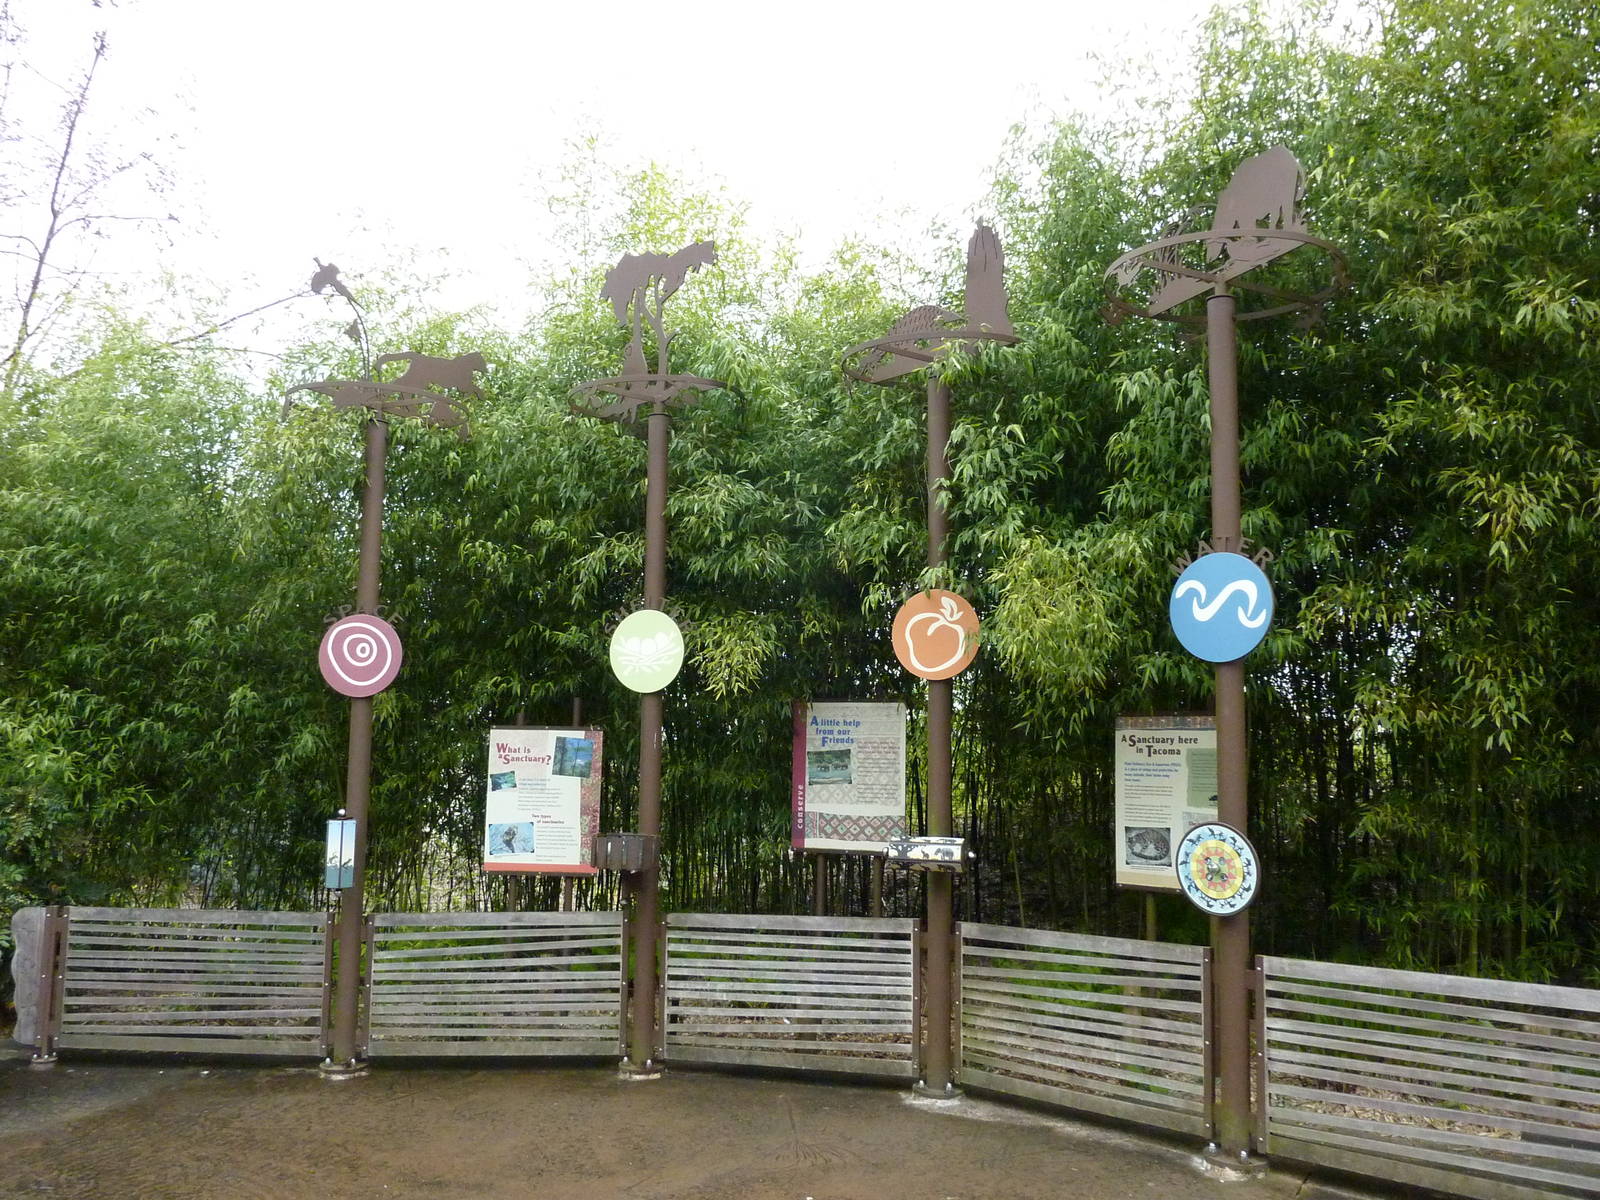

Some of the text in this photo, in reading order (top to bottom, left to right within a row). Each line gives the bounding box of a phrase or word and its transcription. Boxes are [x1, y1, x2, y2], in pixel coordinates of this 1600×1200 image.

[1168, 536, 1275, 577] WATER
[810, 715, 818, 726] A
[843, 719, 861, 728] help
[816, 727, 834, 735] from
[821, 736, 855, 747] Friends
[1121, 734, 1199, 747] A Sanctuary here
[496, 743, 521, 754] What
[1136, 745, 1181, 757] in Tacoma
[503, 754, 552, 765] Sanctuary?
